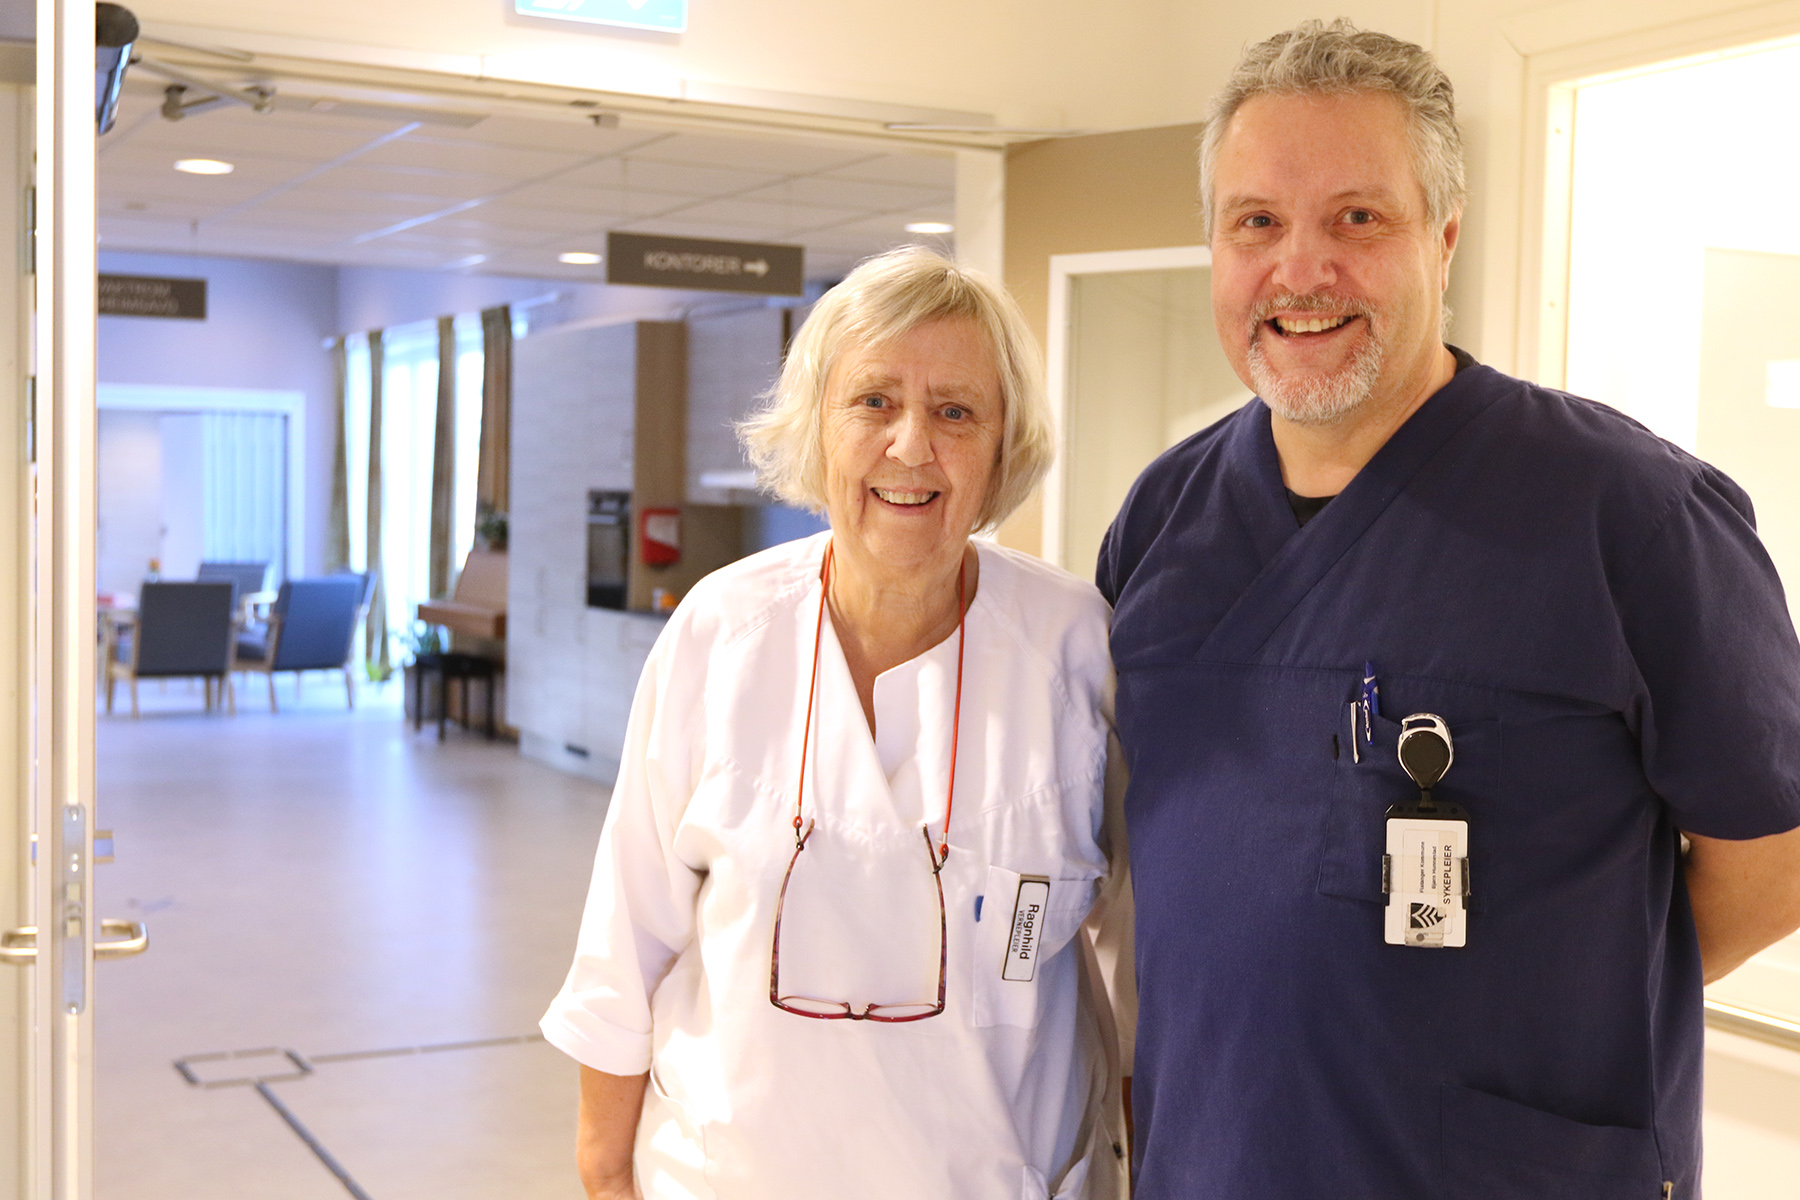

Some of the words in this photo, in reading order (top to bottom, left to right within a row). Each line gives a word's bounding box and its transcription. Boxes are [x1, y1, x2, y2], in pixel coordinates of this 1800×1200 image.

[643, 251, 742, 275] KONTORER
[1443, 845, 1452, 905] SYKEPLEIER
[1012, 910, 1025, 952] VERNEPLEIER
[1019, 904, 1040, 960] Ragnhild
